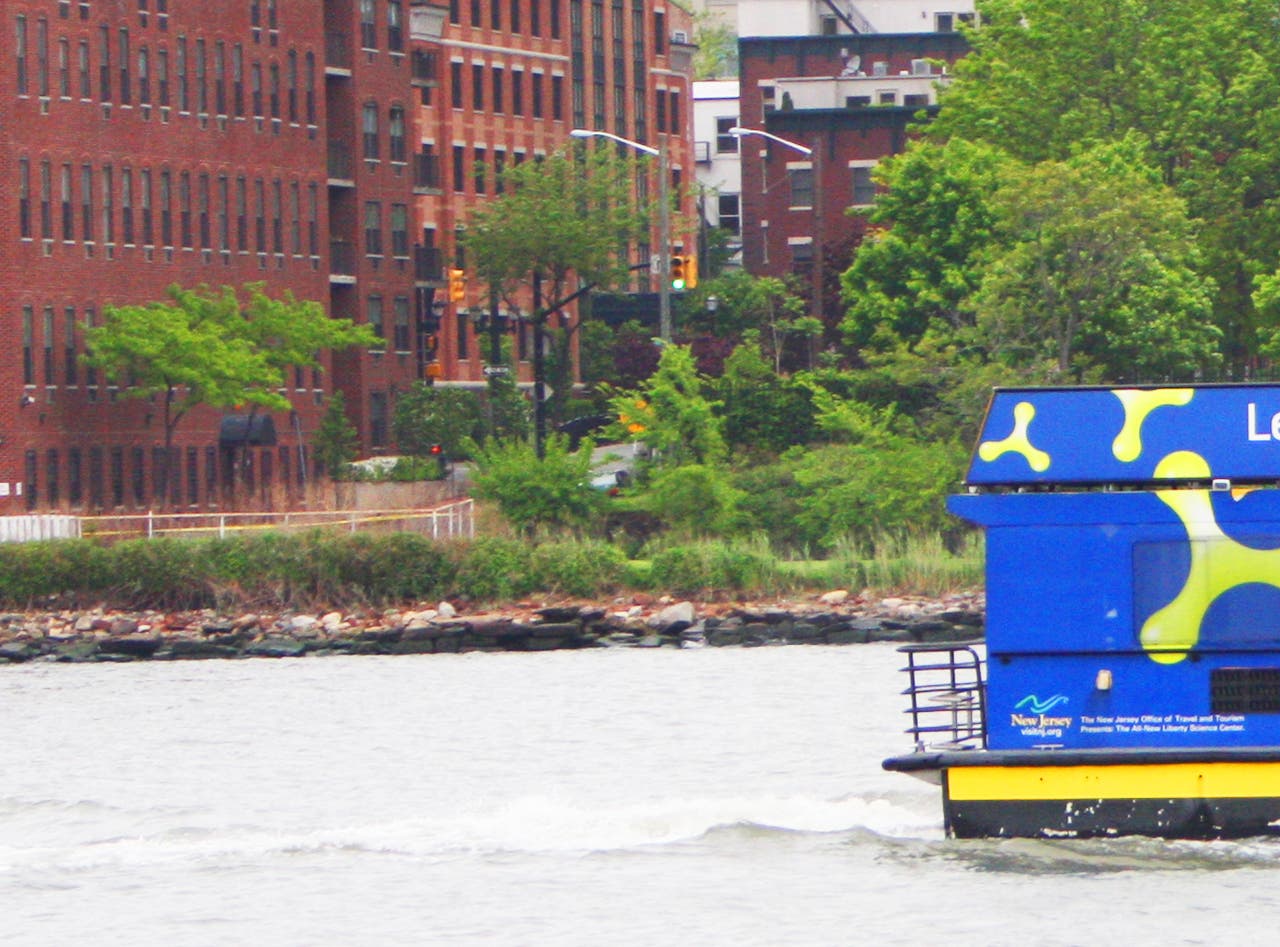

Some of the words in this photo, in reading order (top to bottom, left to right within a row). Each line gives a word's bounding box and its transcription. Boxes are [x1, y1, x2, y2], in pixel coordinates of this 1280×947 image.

[1010, 713, 1038, 727] New
[1038, 713, 1073, 728] Jersey
[1115, 716, 1140, 724] Jersey
[1141, 715, 1163, 723] Office
[1164, 715, 1173, 723] of
[1175, 714, 1198, 722] Travel
[1199, 714, 1214, 722] and
[1215, 714, 1245, 722] Tourism
[1021, 727, 1063, 738] visitnj.org
[1162, 724, 1189, 733] Liberty
